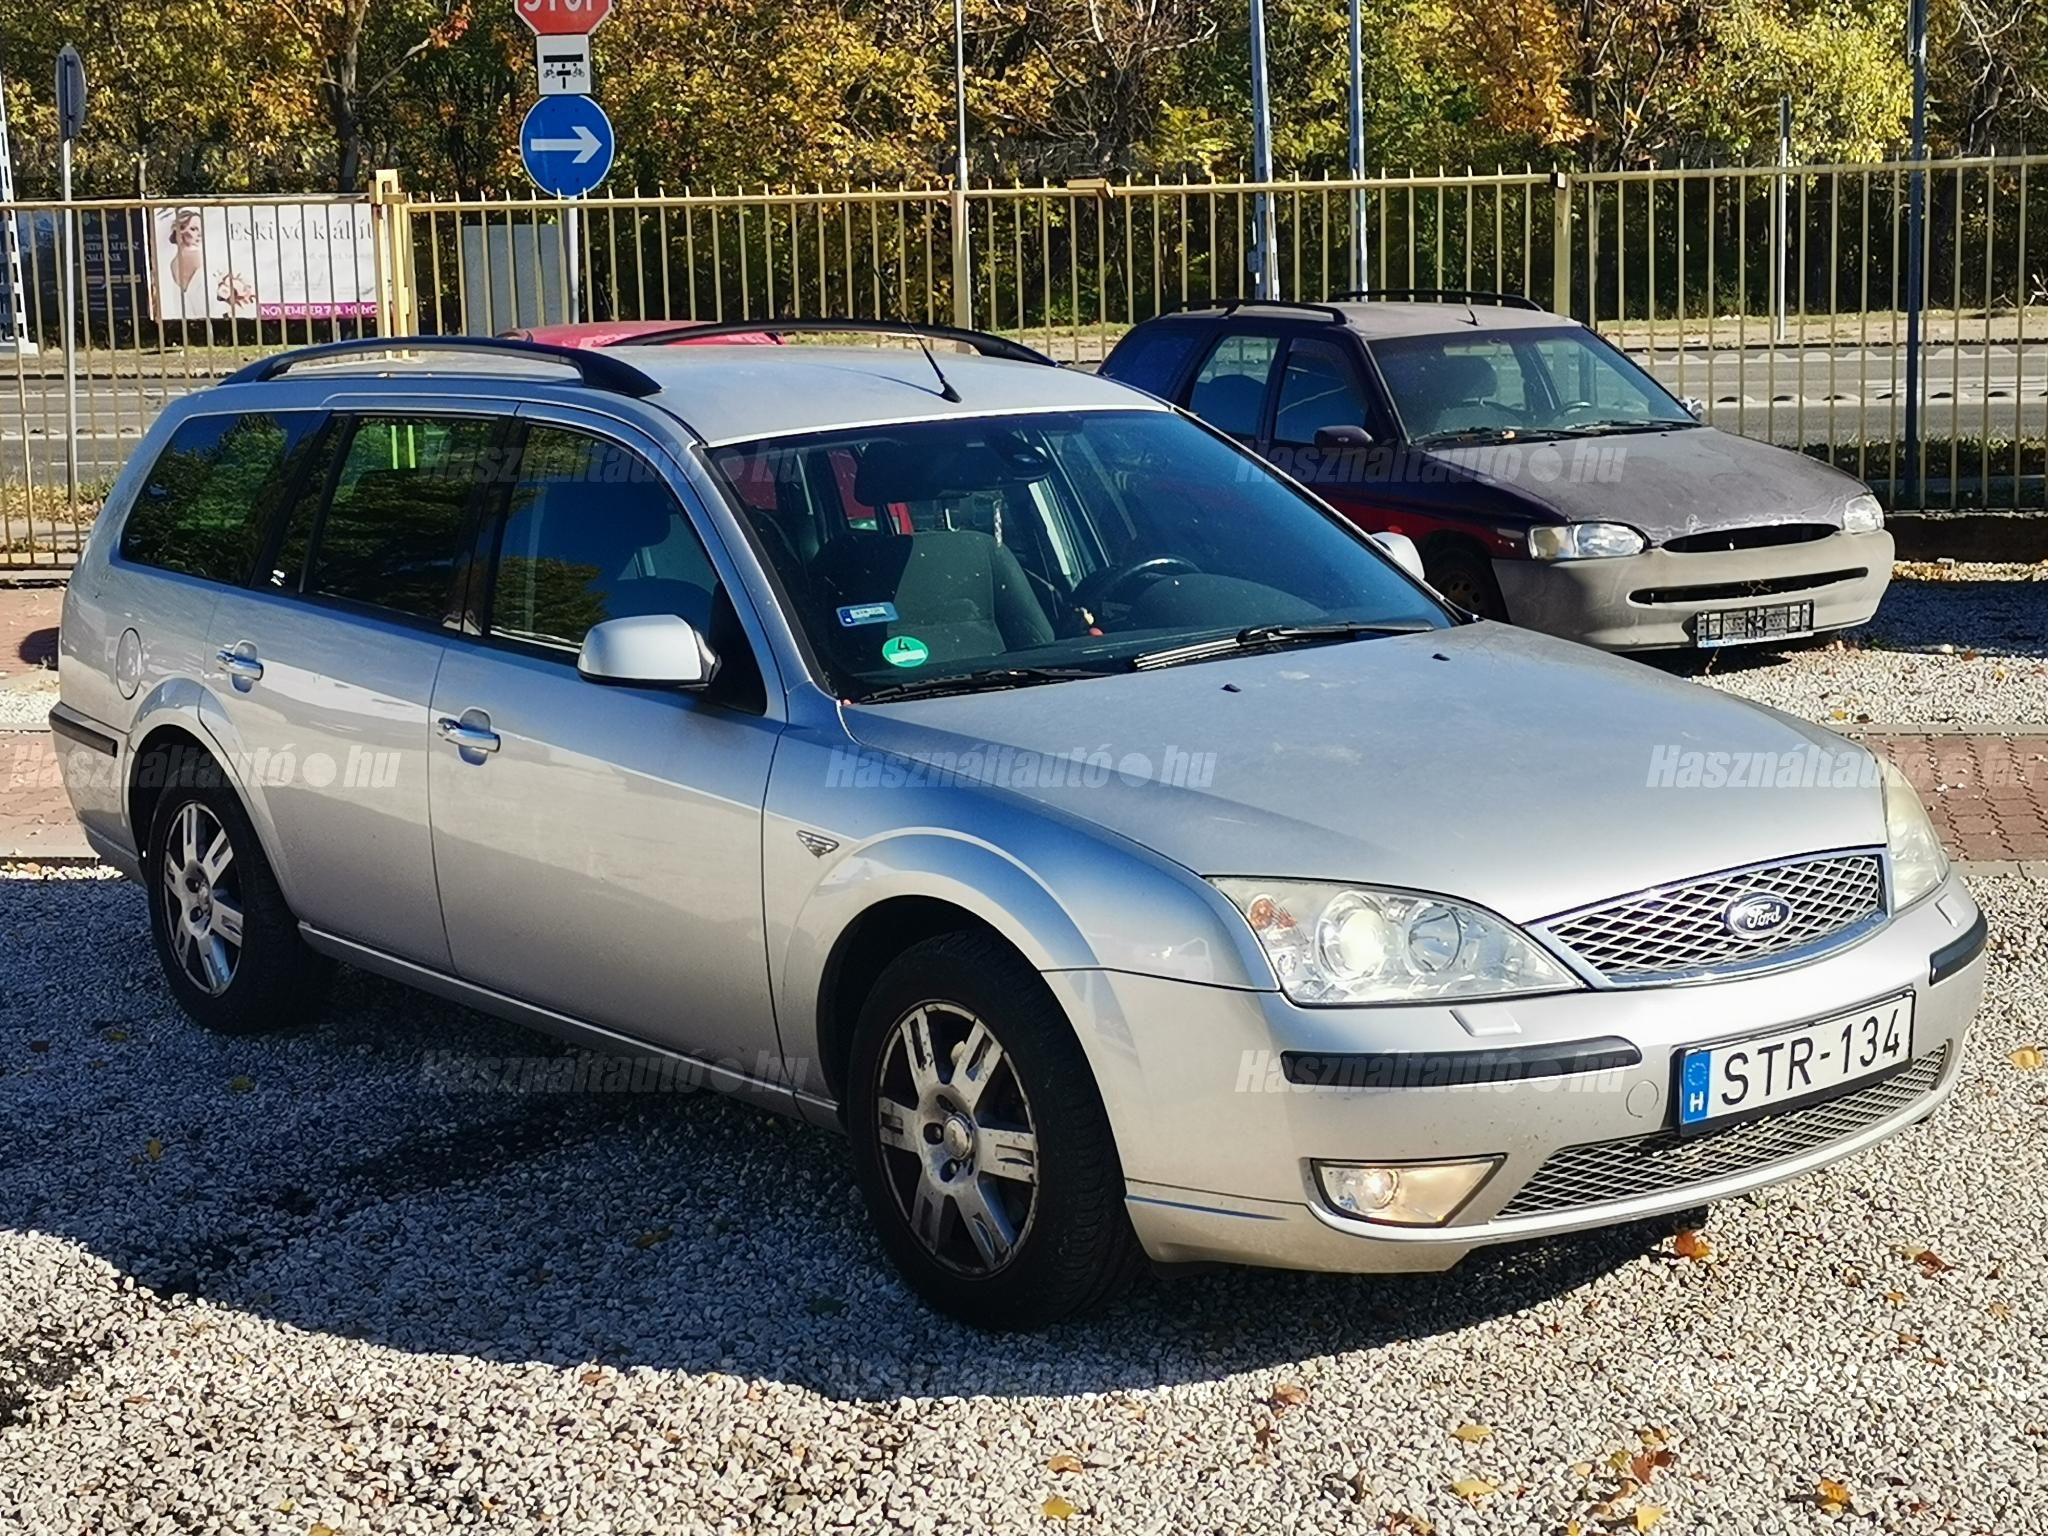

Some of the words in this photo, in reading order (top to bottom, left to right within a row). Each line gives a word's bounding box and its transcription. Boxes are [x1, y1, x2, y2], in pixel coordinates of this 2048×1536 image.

[897, 638, 911, 652] 4
[1746, 901, 1783, 929] Ford
[1688, 1091, 1705, 1113] H
[1720, 1007, 1901, 1107] STR-134
